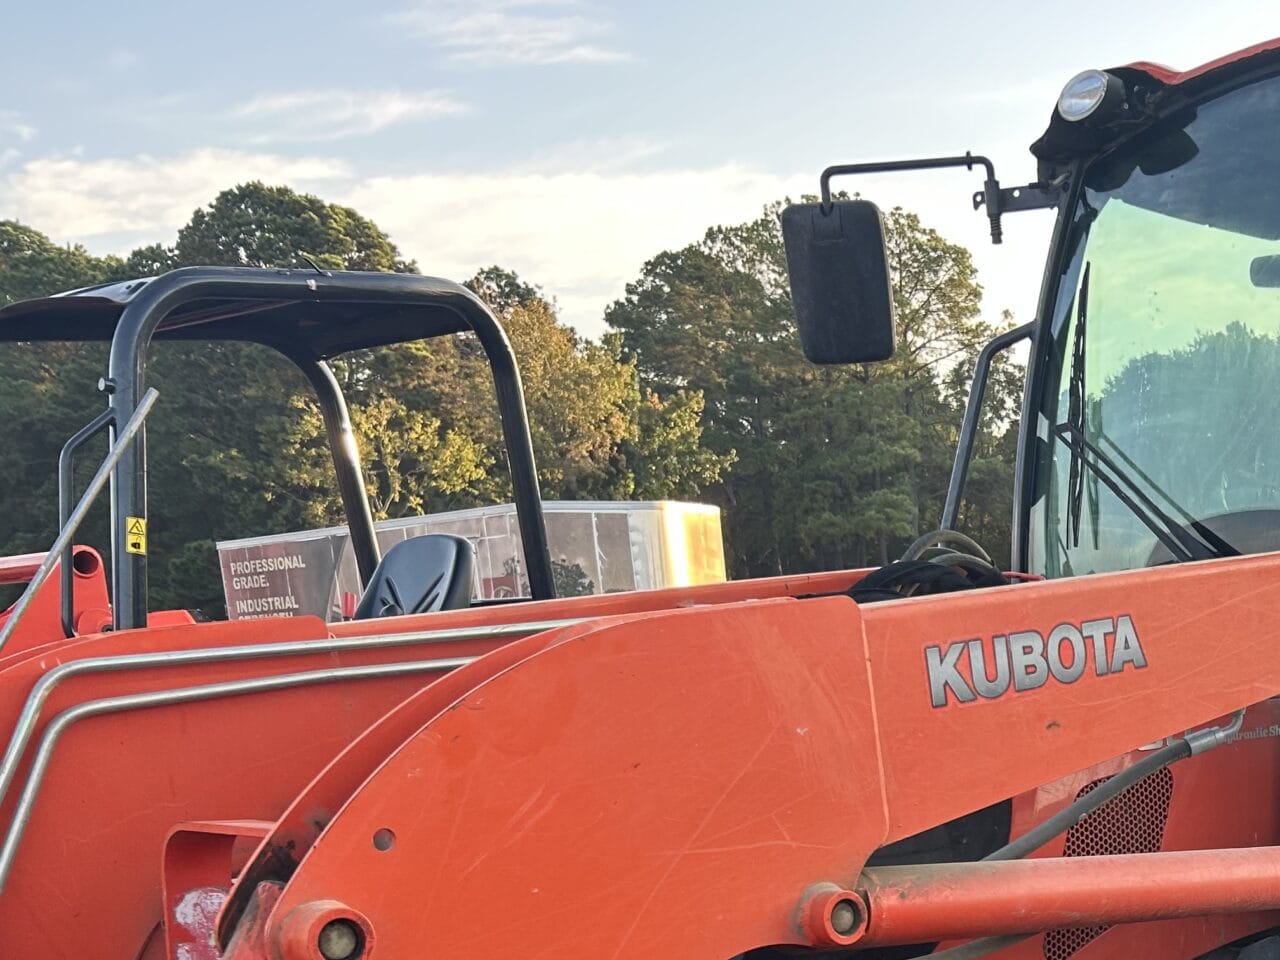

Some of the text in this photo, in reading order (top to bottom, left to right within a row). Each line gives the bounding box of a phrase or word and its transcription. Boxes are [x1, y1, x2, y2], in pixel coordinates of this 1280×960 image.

[230, 555, 306, 575] PROFESSIONAL
[232, 574, 270, 590] GRADE.
[236, 595, 299, 614] INDUSTRIAL
[924, 614, 1149, 709] KUBOTA
[1224, 726, 1268, 745] ydraulic
